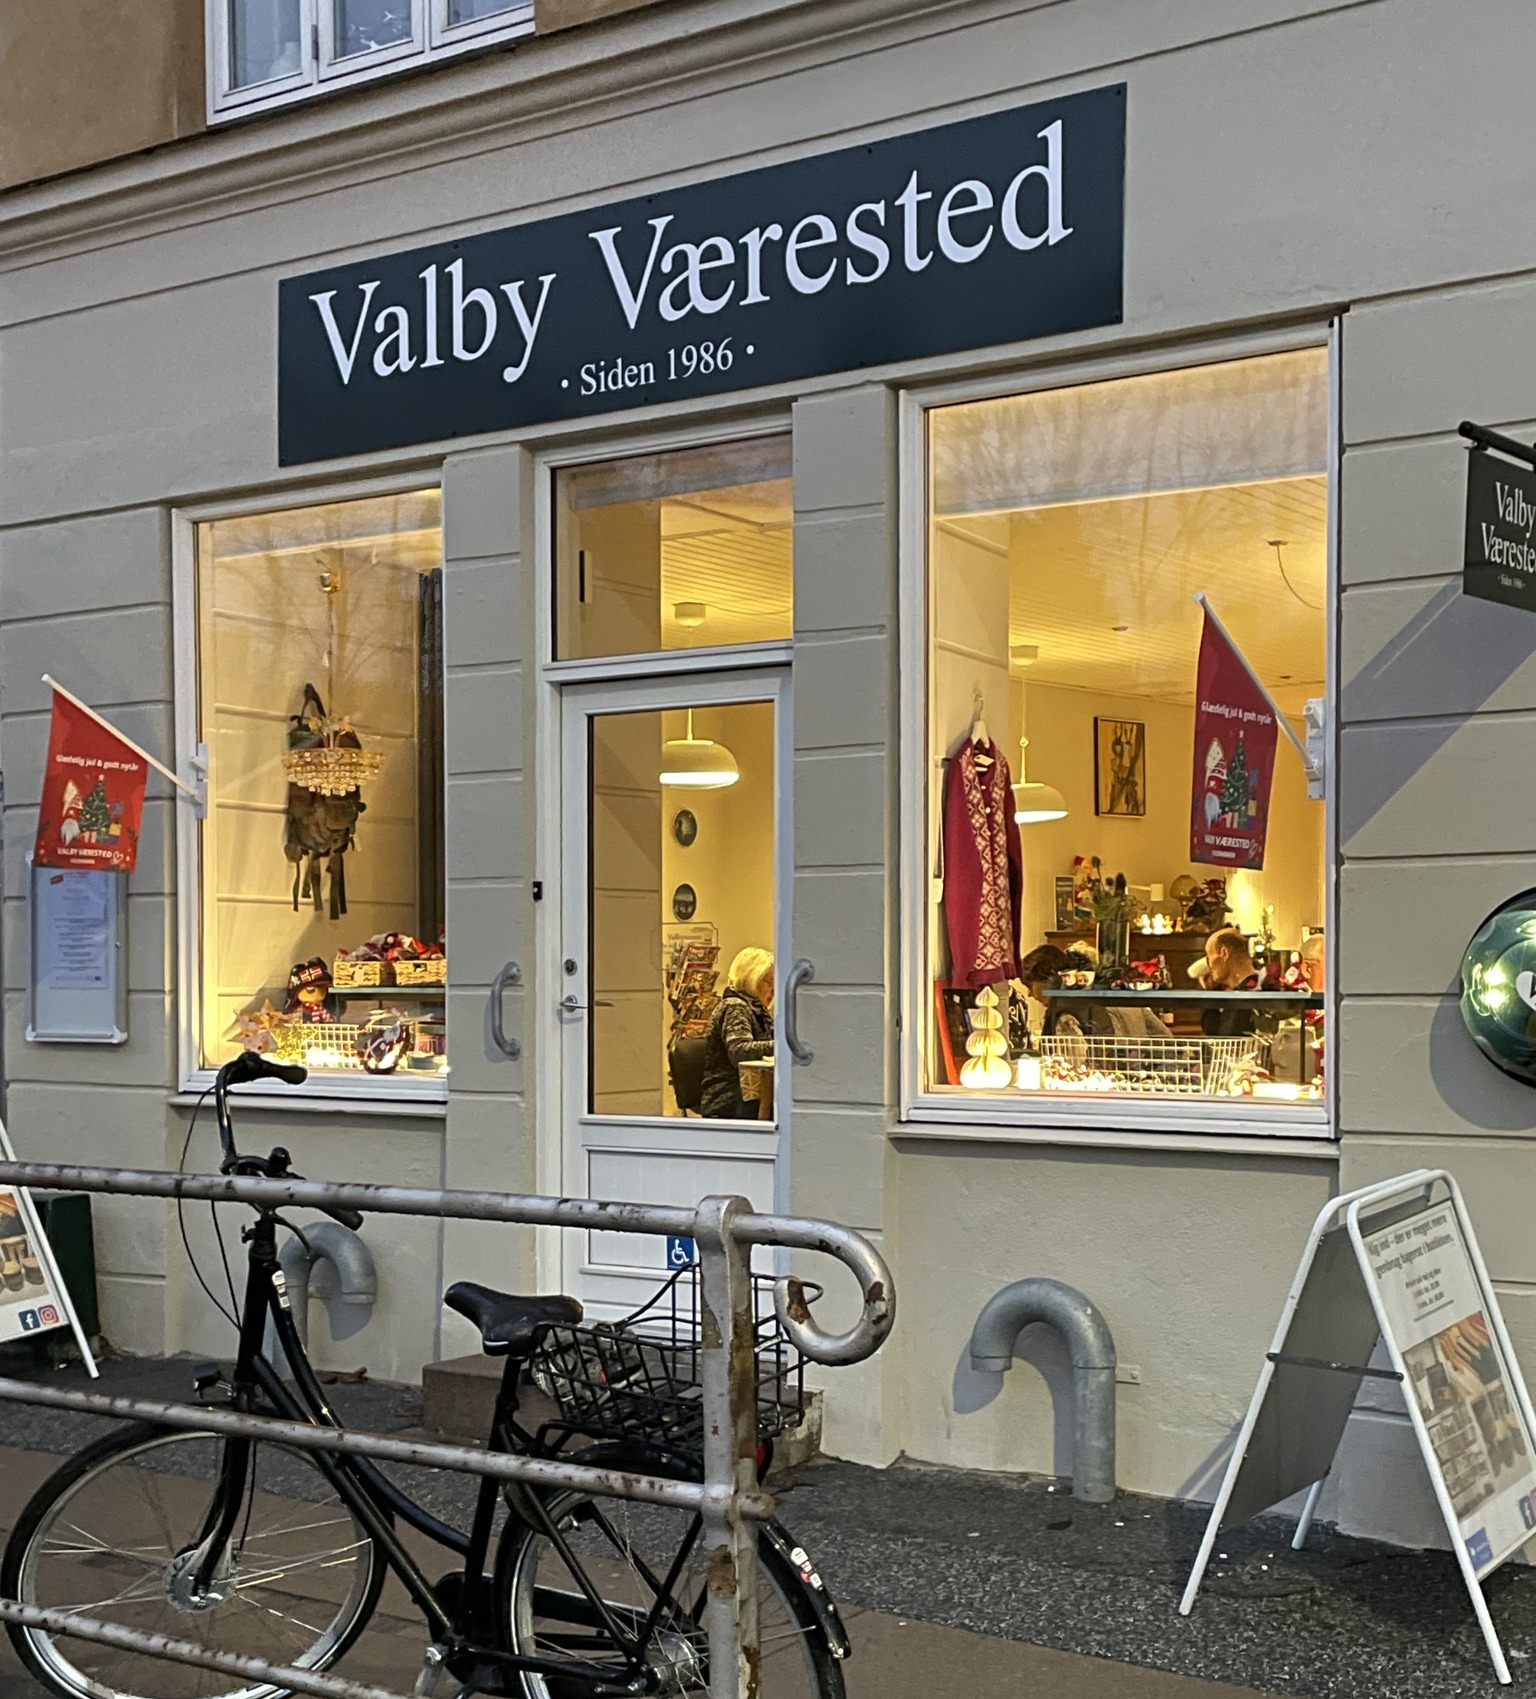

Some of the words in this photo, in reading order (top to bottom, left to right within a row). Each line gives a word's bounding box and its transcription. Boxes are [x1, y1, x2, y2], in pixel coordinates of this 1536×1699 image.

[308, 257, 557, 384] Valby
[588, 119, 1074, 330] Værested
[580, 357, 656, 397] Siden
[667, 337, 734, 380] 1986
[1495, 481, 1536, 539] Valby
[1481, 522, 1536, 575] Væreste
[1238, 708, 1243, 719] &
[96, 758, 103, 768] &
[1215, 836, 1250, 849] VÆRESTED
